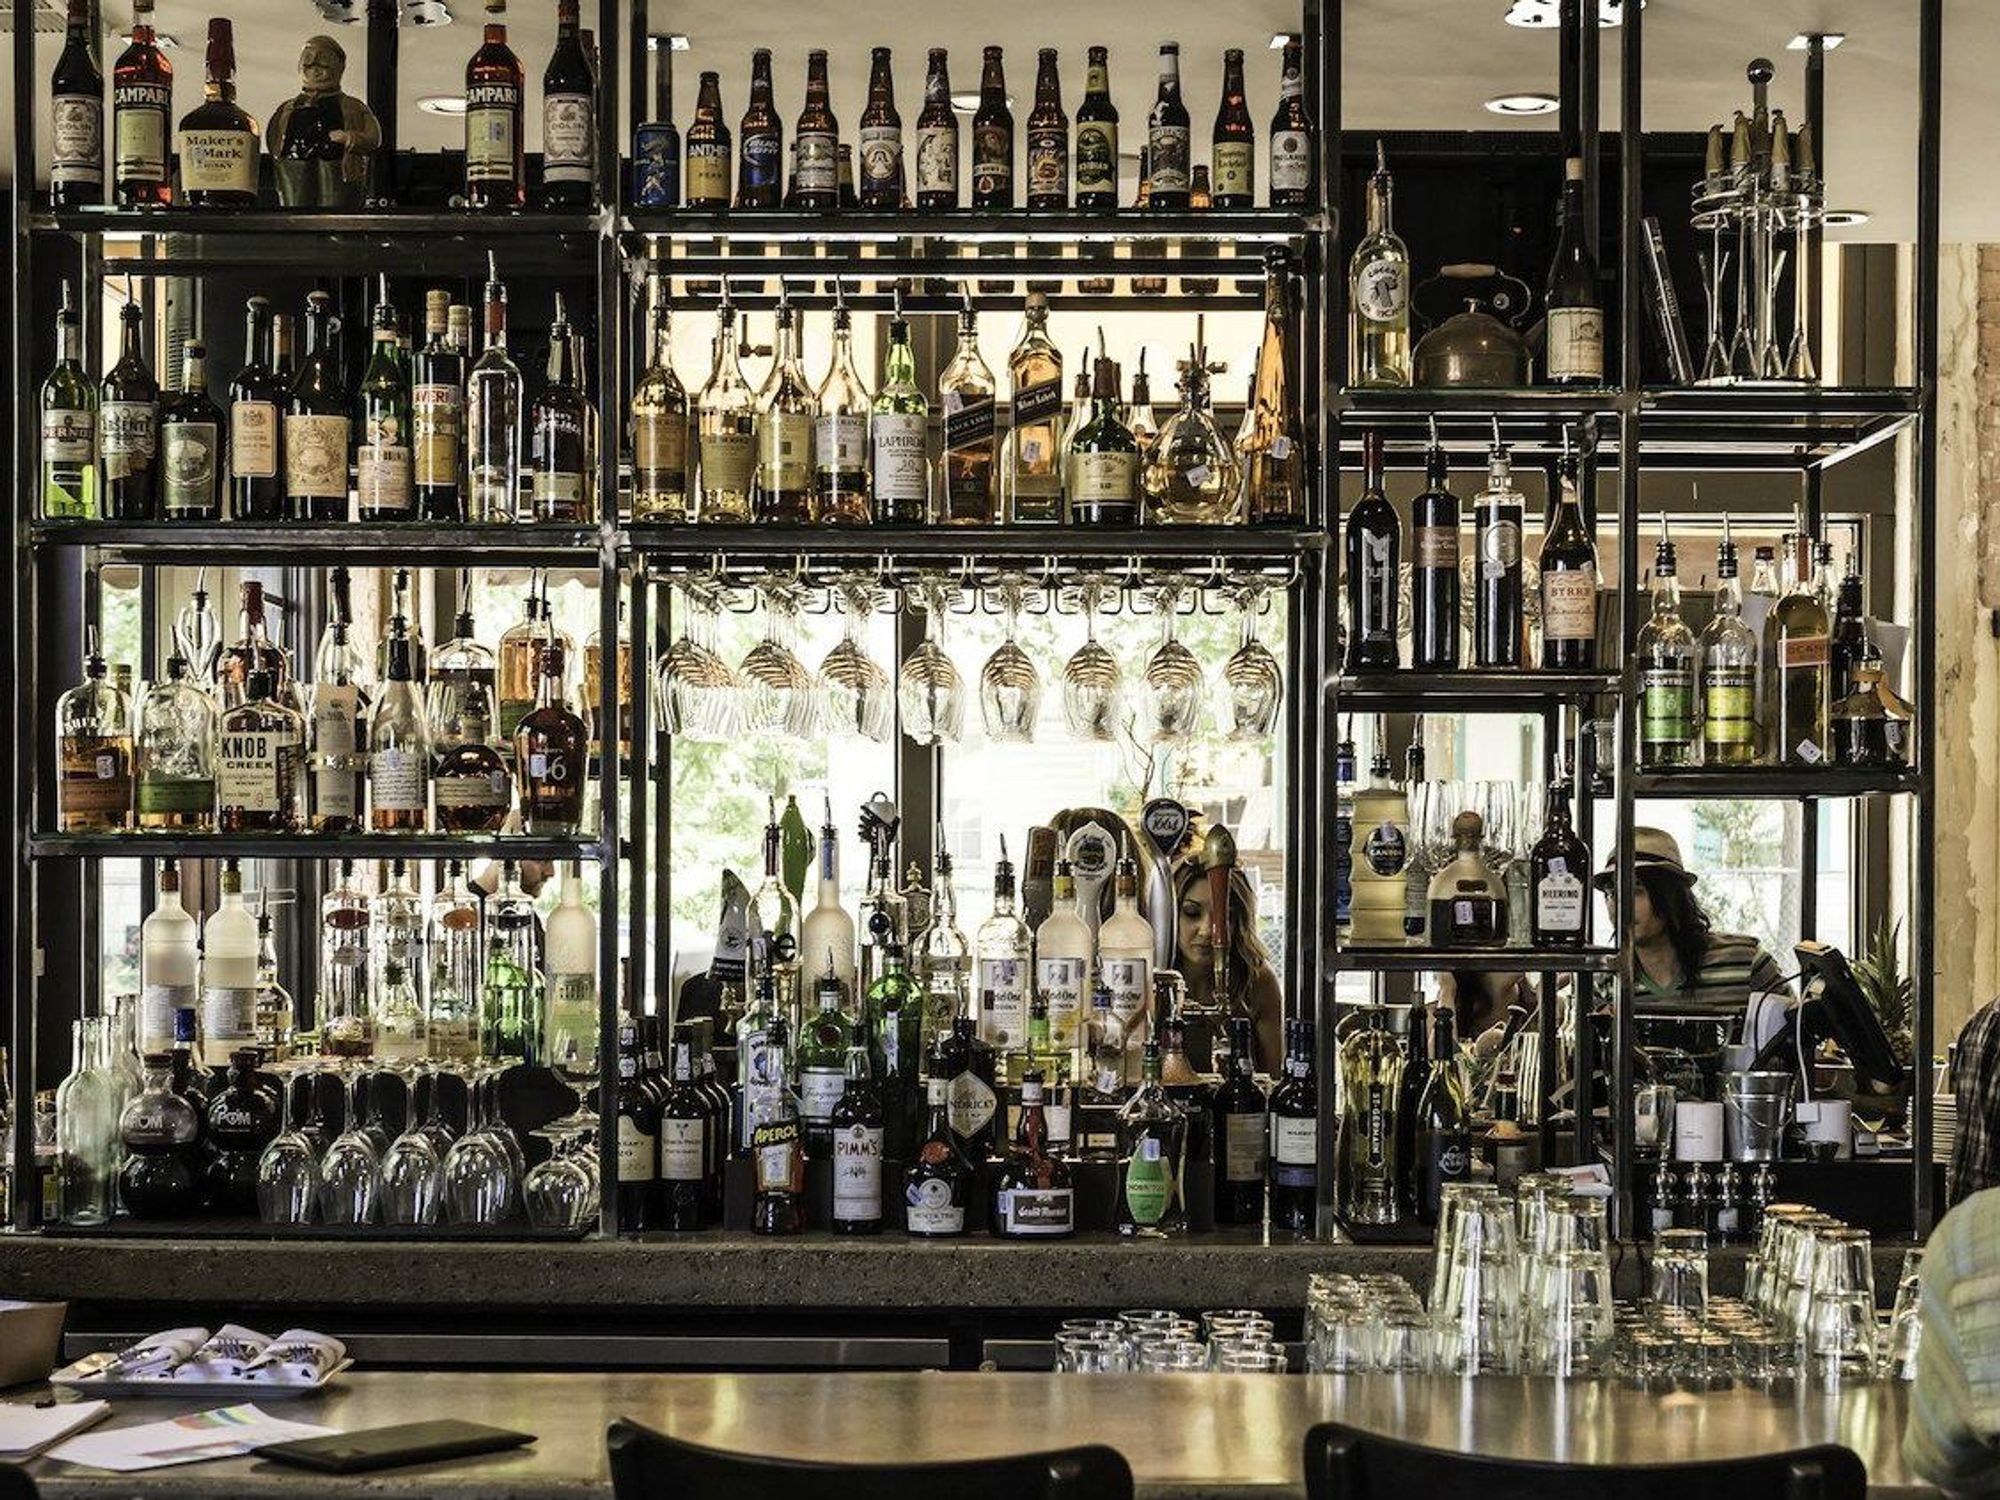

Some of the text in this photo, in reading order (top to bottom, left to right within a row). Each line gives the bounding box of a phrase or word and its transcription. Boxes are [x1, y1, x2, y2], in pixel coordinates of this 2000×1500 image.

[185, 136, 244, 146] Maker's
[203, 148, 242, 159] Mark
[221, 737, 267, 759] KNOB
[226, 761, 273, 769] CREEK
[755, 1125, 798, 1144] APEROL
[836, 1139, 879, 1156] PIMM'S
